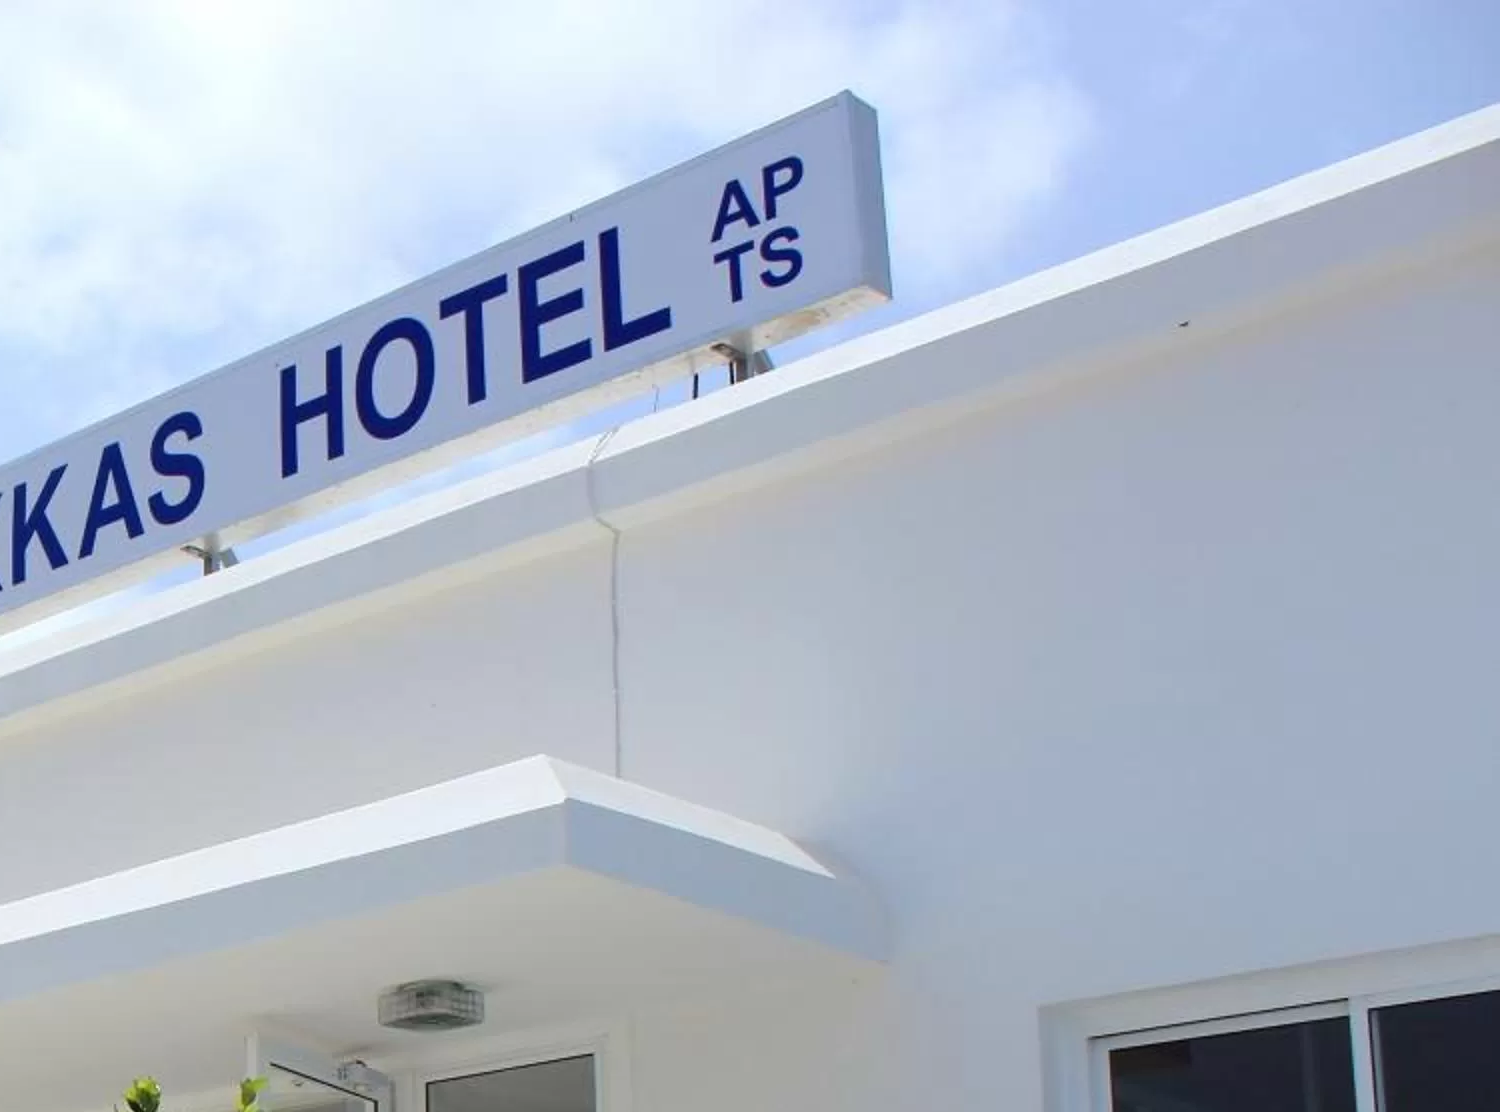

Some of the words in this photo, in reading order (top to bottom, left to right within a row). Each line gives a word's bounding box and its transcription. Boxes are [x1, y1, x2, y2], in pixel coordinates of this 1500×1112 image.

[711, 155, 805, 244] AP
[712, 225, 804, 304] TS
[279, 225, 673, 479] HOTEL
